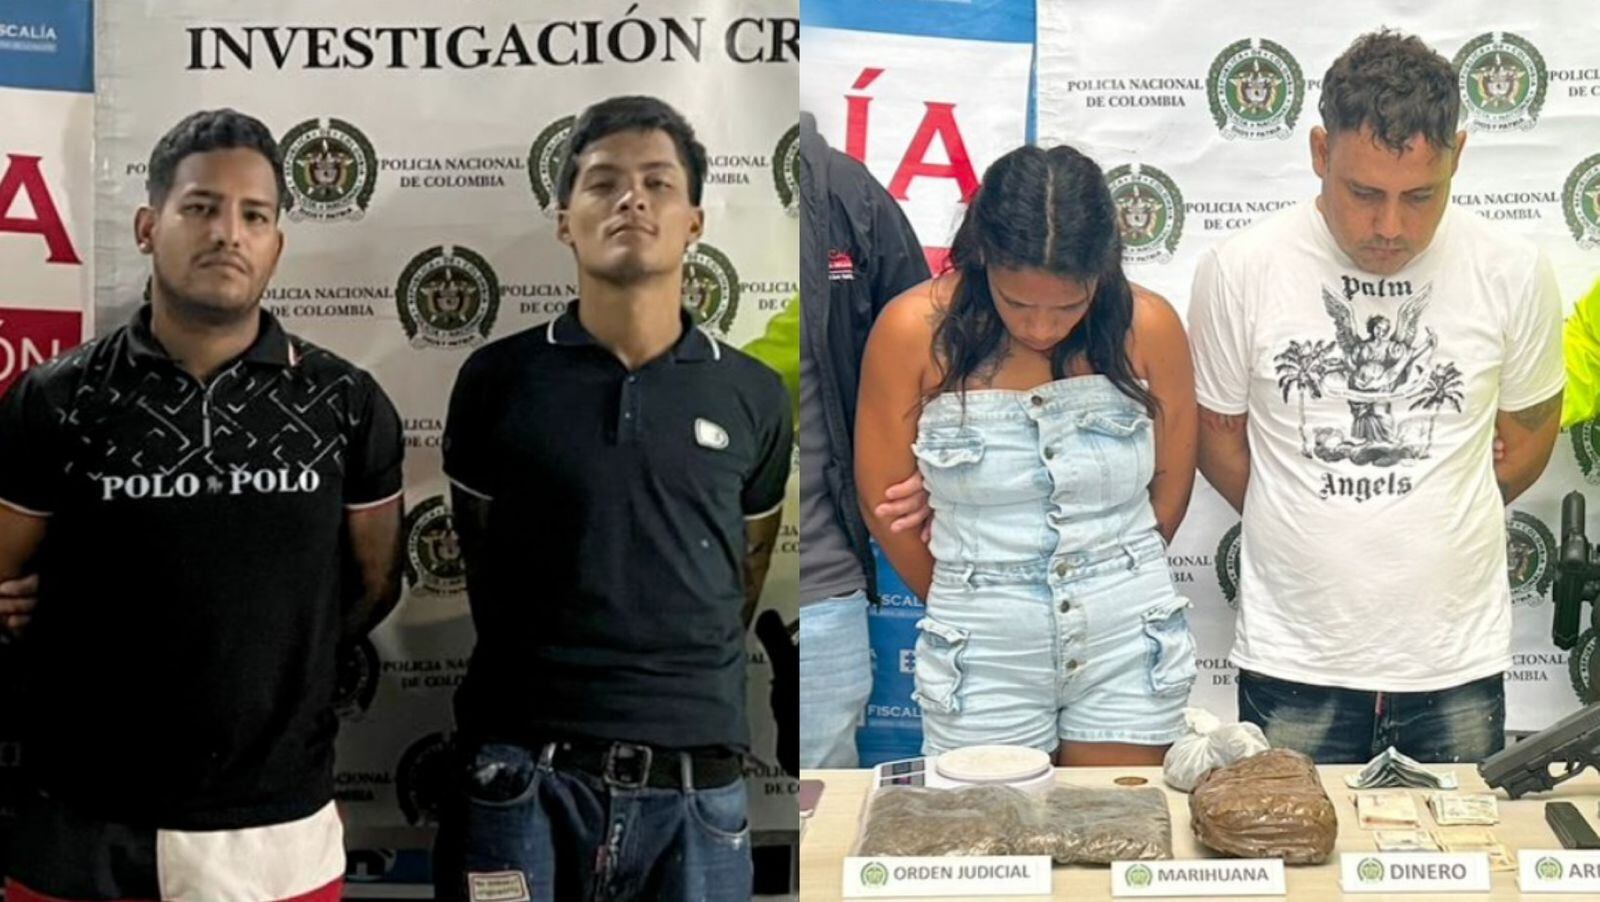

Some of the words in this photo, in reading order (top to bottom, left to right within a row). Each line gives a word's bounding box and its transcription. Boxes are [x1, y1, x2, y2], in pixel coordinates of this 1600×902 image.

[186, 3, 705, 71] INVESTIGACIÓN
[1067, 79, 1126, 92] POLICIA
[1129, 78, 1203, 90] NACIONAL
[1568, 86, 1588, 97] DE
[1086, 95, 1105, 108] DE
[1108, 95, 1185, 108] COLOMBIA
[381, 158, 442, 171] POLICIA
[445, 157, 524, 170] NACIONAL
[400, 175, 421, 188] DE
[423, 175, 505, 188] COLOMBIA
[1484, 191, 1559, 204] NACIONAL
[1185, 201, 1242, 213] POLICIA
[1203, 218, 1223, 230] DE
[314, 286, 393, 299] NACIONAL
[500, 284, 562, 297] POLICIA
[740, 281, 799, 293] POLICIA
[1341, 275, 1413, 301] Palm
[520, 302, 540, 314] DE
[758, 298, 778, 310] DE
[270, 305, 290, 318] DE
[293, 304, 375, 317] COLOMBIA
[101, 473, 200, 501] POLO
[229, 469, 320, 495] POLO
[1320, 472, 1412, 503] Angels
[383, 661, 442, 673] POLICIA
[1212, 674, 1231, 686] DE
[765, 783, 784, 795] DE
[893, 866, 953, 881] ORDEN
[957, 864, 1031, 880] JUDICIAL
[1158, 867, 1269, 882] MARIHUANA
[1390, 863, 1467, 880] DINERO
